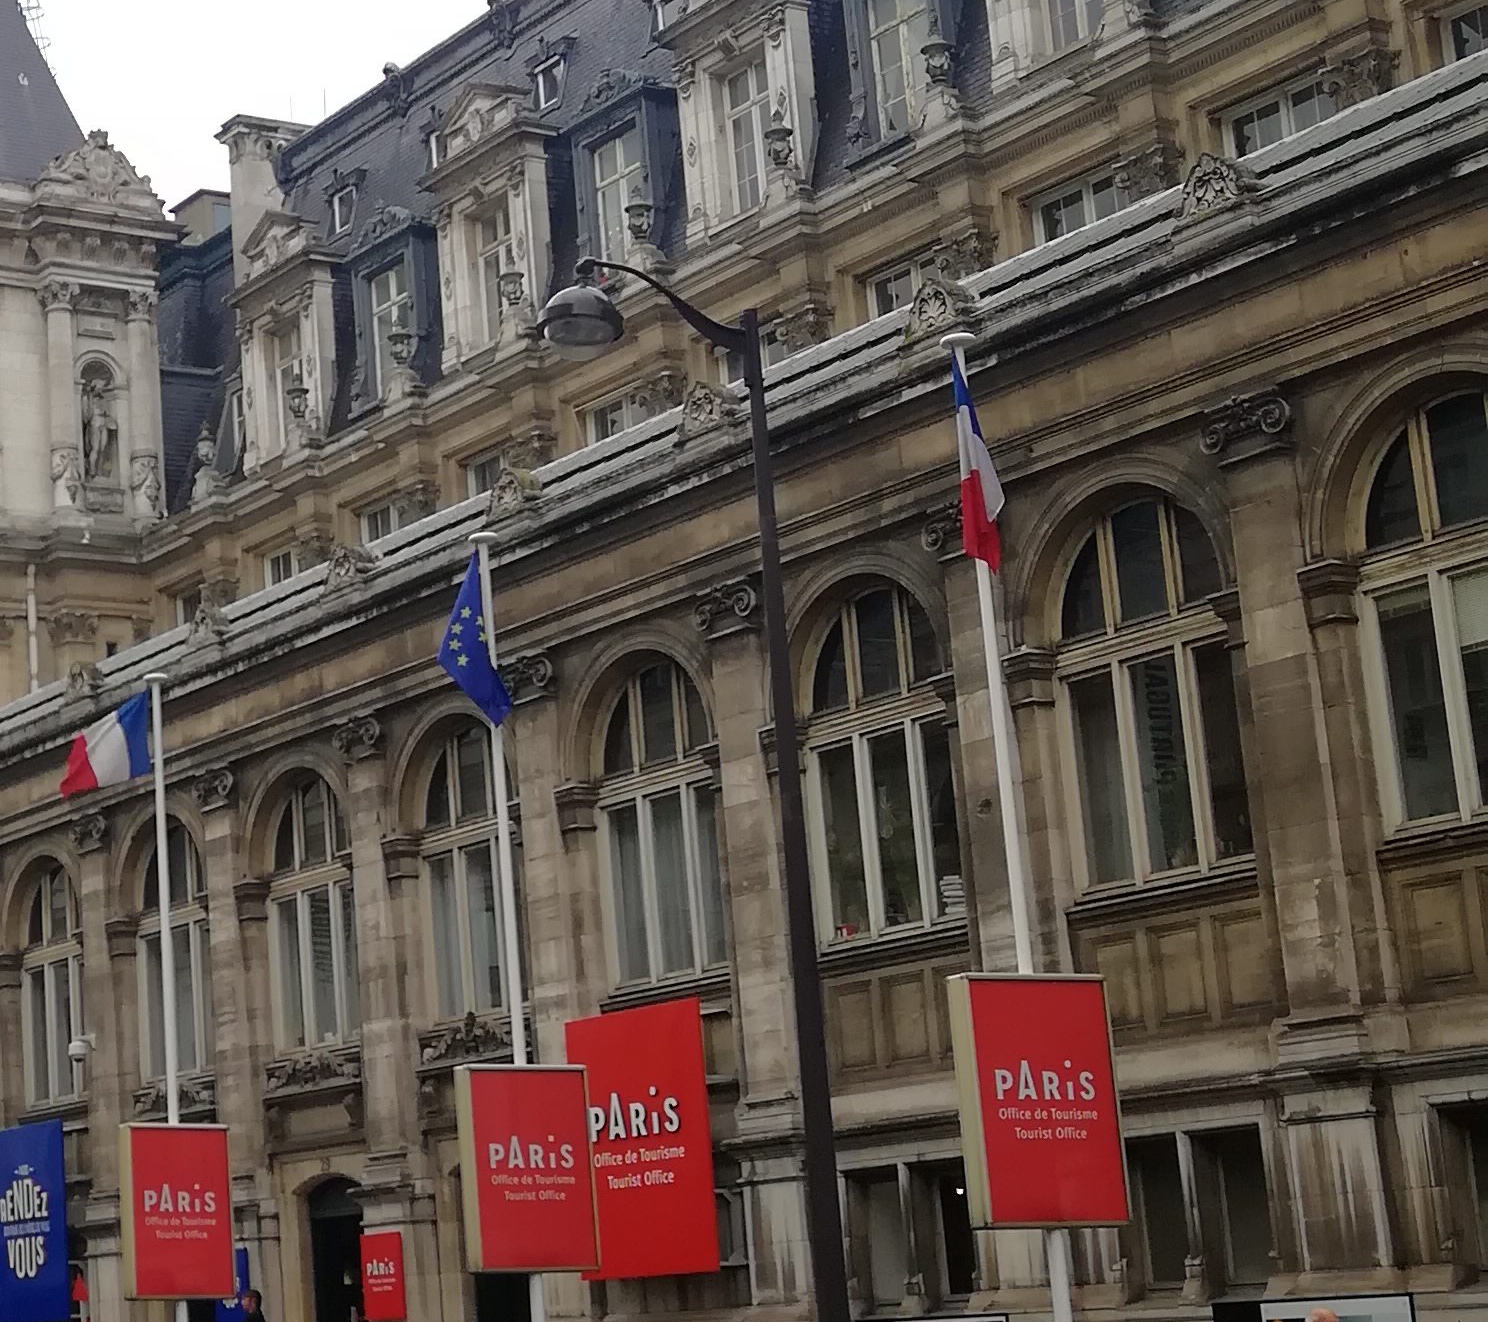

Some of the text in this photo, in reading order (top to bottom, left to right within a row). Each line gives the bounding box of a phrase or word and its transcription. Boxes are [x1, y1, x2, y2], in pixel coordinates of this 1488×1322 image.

[998, 1107, 1098, 1120] Office de Tourisme
[1014, 1126, 1087, 1139] Tourist Office
[593, 1145, 685, 1168] Office de Tourisme
[607, 1169, 675, 1190] Tourist Office
[7, 1235, 45, 1279] VOUS
